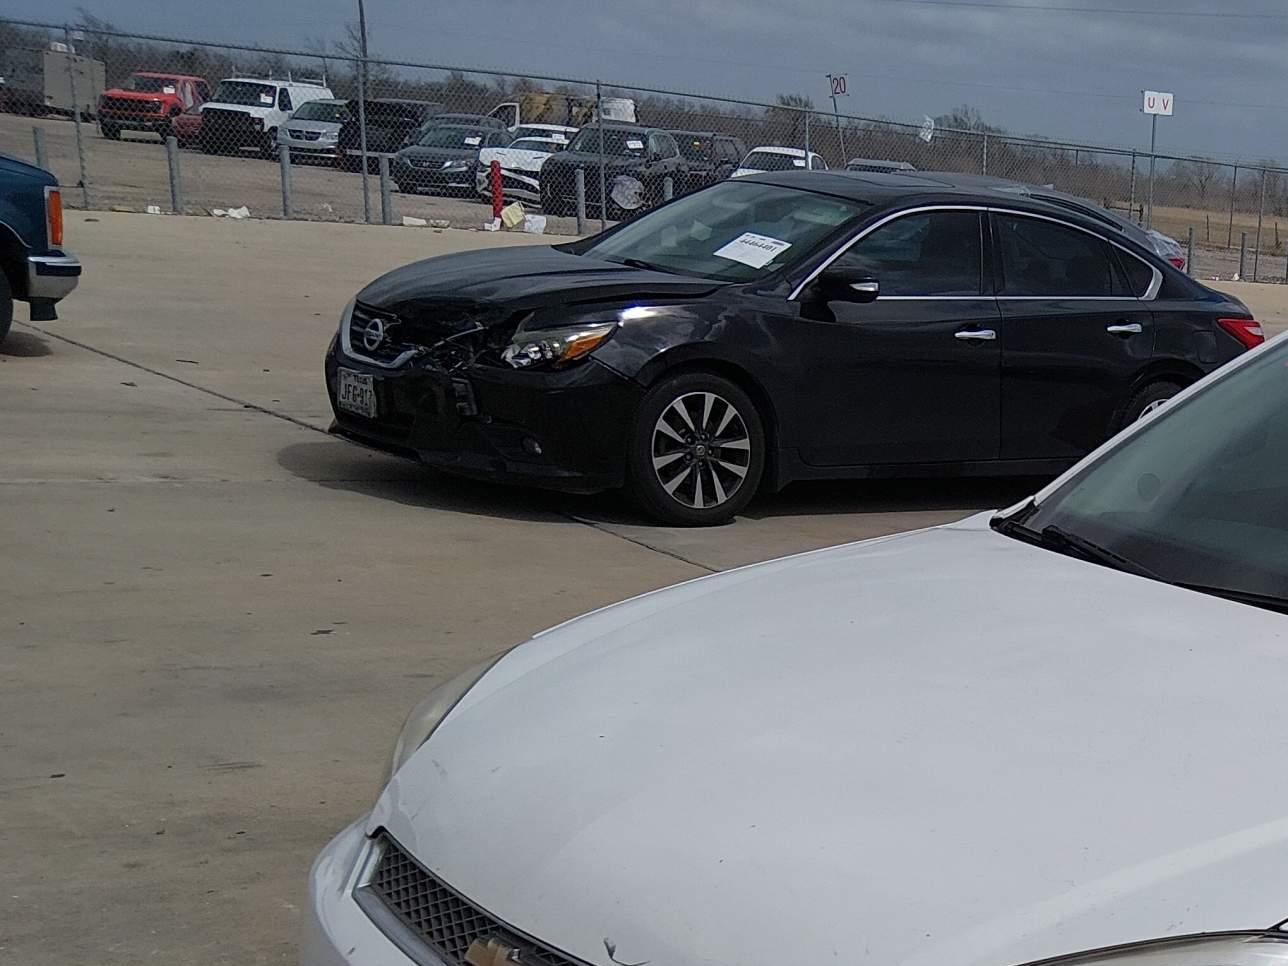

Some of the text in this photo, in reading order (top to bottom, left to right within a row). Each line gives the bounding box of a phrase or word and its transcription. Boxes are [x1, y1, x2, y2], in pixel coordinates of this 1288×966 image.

[832, 76, 846, 94] 20
[1148, 97, 1170, 111] U V
